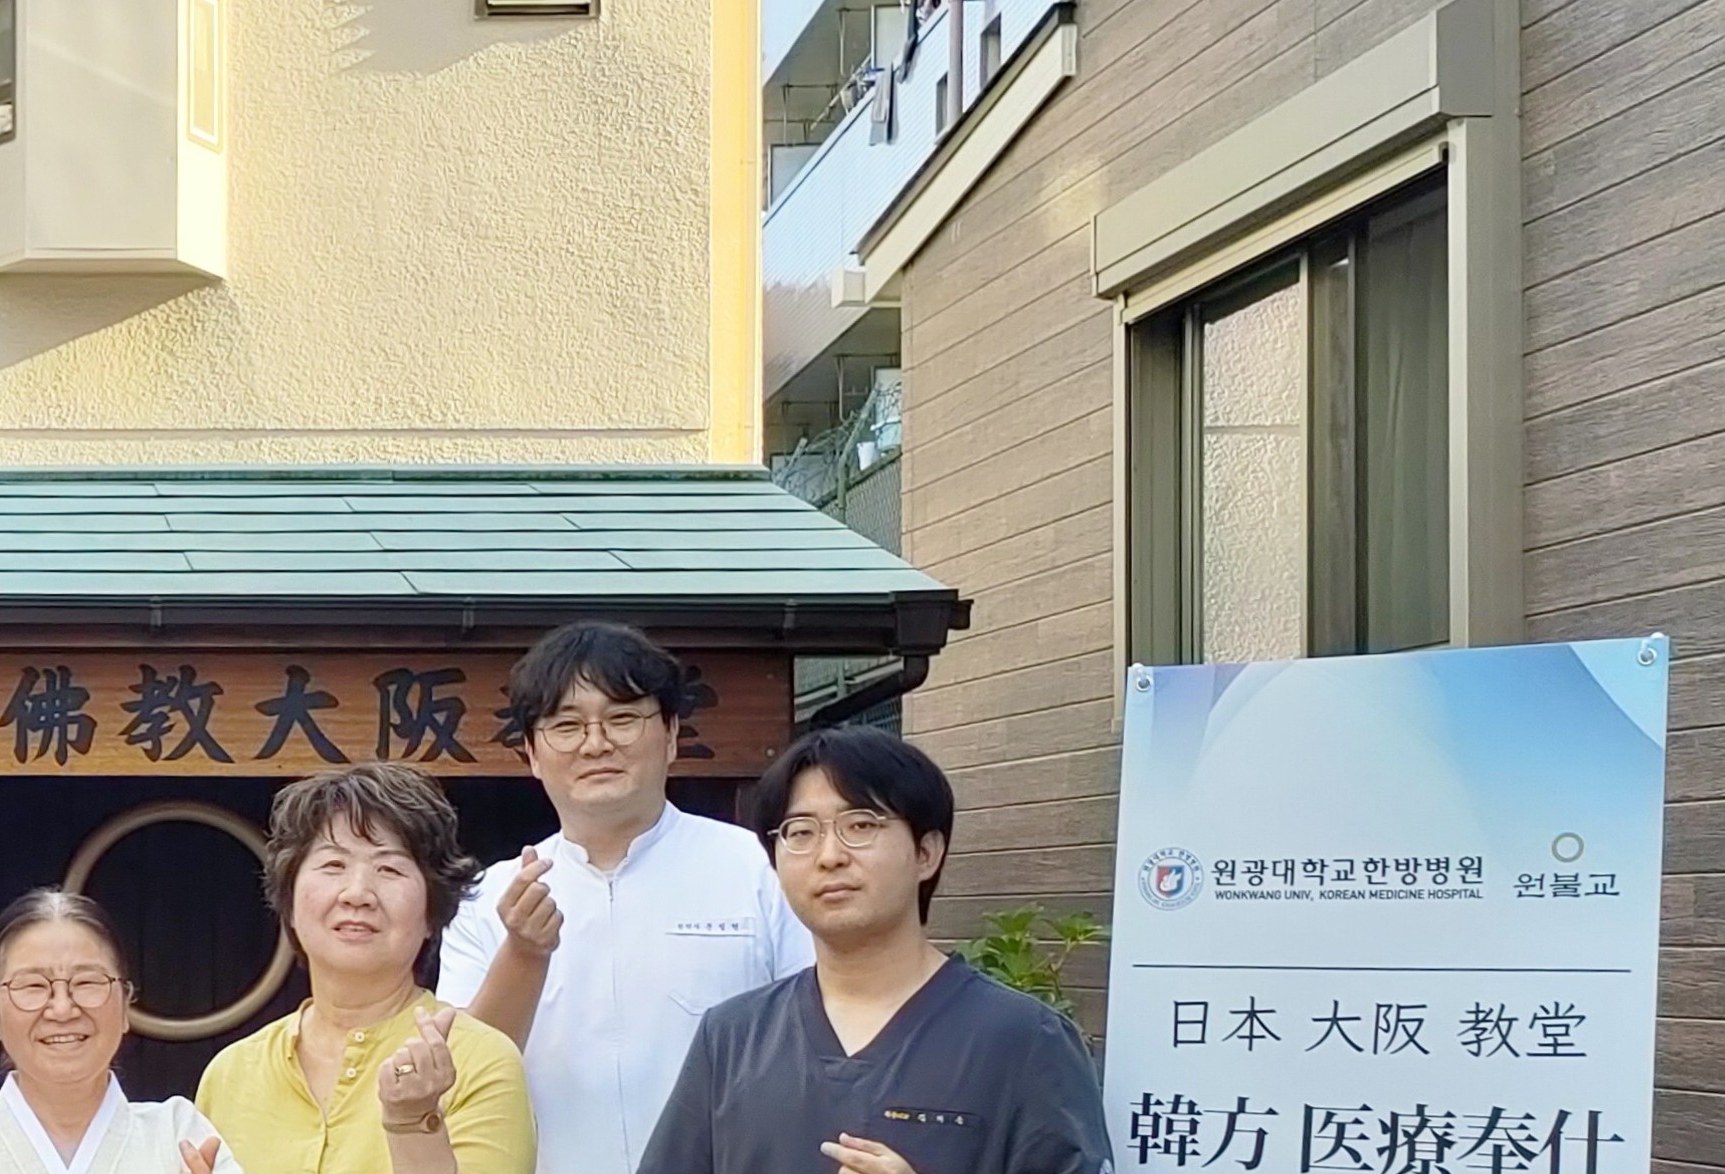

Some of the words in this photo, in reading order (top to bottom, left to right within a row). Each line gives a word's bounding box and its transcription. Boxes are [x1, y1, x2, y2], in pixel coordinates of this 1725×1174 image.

[1211, 855, 1485, 887] 원광대학교한방병원
[1513, 872, 1621, 899] 원불교
[1215, 889, 1281, 900] WONKWANG
[1319, 888, 1366, 900] KOREAN
[1369, 888, 1425, 899] MEDICINE
[1428, 887, 1484, 899] HOSPITAL
[1173, 996, 1283, 1052] 日本
[1304, 999, 1430, 1056] 大阪
[1457, 1001, 1588, 1058] 教堂
[1127, 1091, 1278, 1171] 韓方
